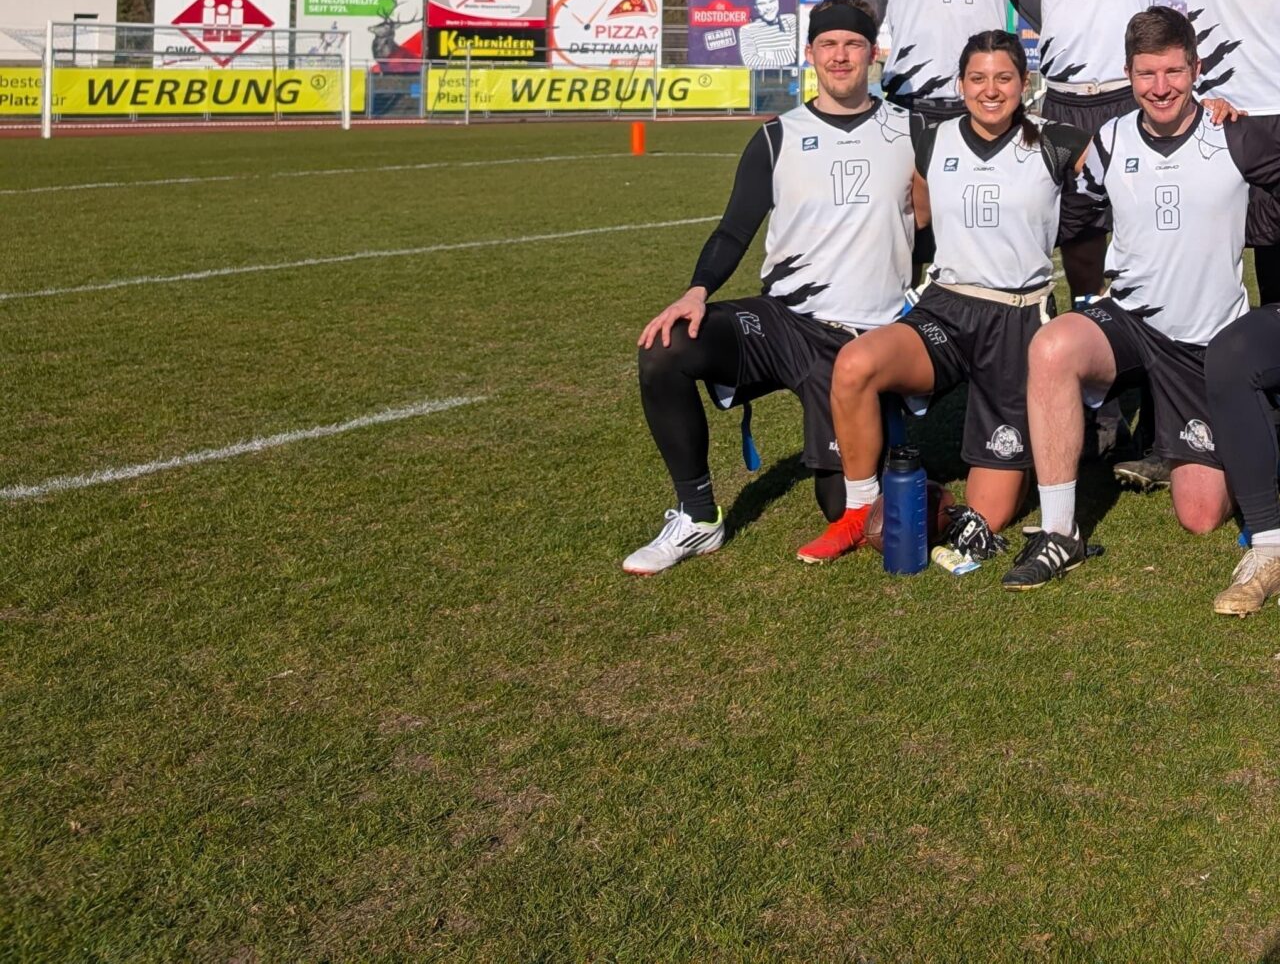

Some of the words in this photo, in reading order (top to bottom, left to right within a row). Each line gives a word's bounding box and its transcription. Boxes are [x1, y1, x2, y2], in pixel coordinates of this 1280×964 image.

[309, 4, 328, 12] SEIT
[694, 10, 747, 23] ROSTOCKER
[595, 25, 659, 39] PIZZA?
[0, 76, 47, 88] beste
[88, 78, 303, 106] WERBUNG
[511, 78, 692, 102] WERBUNG
[0, 94, 39, 106] Platz
[438, 92, 470, 104] Plat
[474, 92, 495, 103] für
[830, 159, 871, 206] 12
[962, 185, 1000, 228] 16
[1154, 185, 1181, 231] 8
